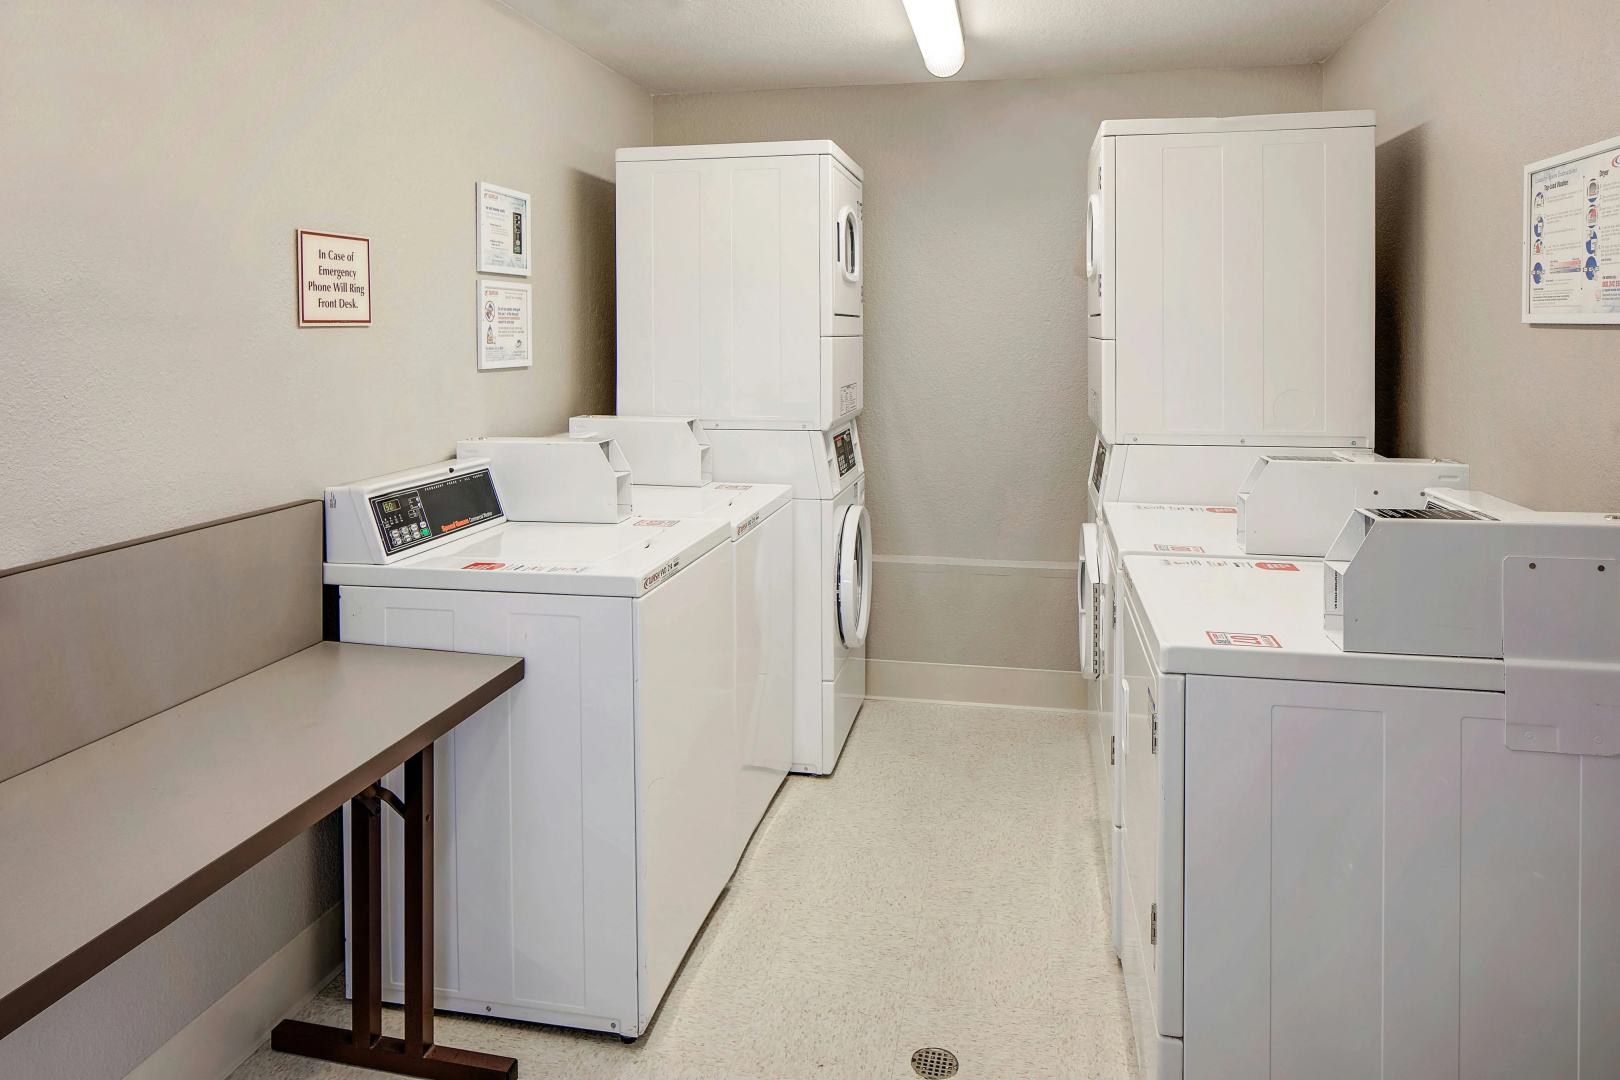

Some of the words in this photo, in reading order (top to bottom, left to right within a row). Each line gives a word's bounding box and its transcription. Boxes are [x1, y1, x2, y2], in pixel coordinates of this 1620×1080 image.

[318, 249, 326, 259] In
[328, 250, 345, 261] Case
[347, 252, 354, 261] of
[318, 265, 356, 280] Emergency
[308, 280, 331, 292] Phone
[333, 282, 348, 292] Will
[349, 283, 365, 297] Ring
[318, 298, 337, 309] Front
[339, 298, 358, 309] Desk.
[441, 521, 456, 532] Speed
[455, 518, 469, 528] Queen
